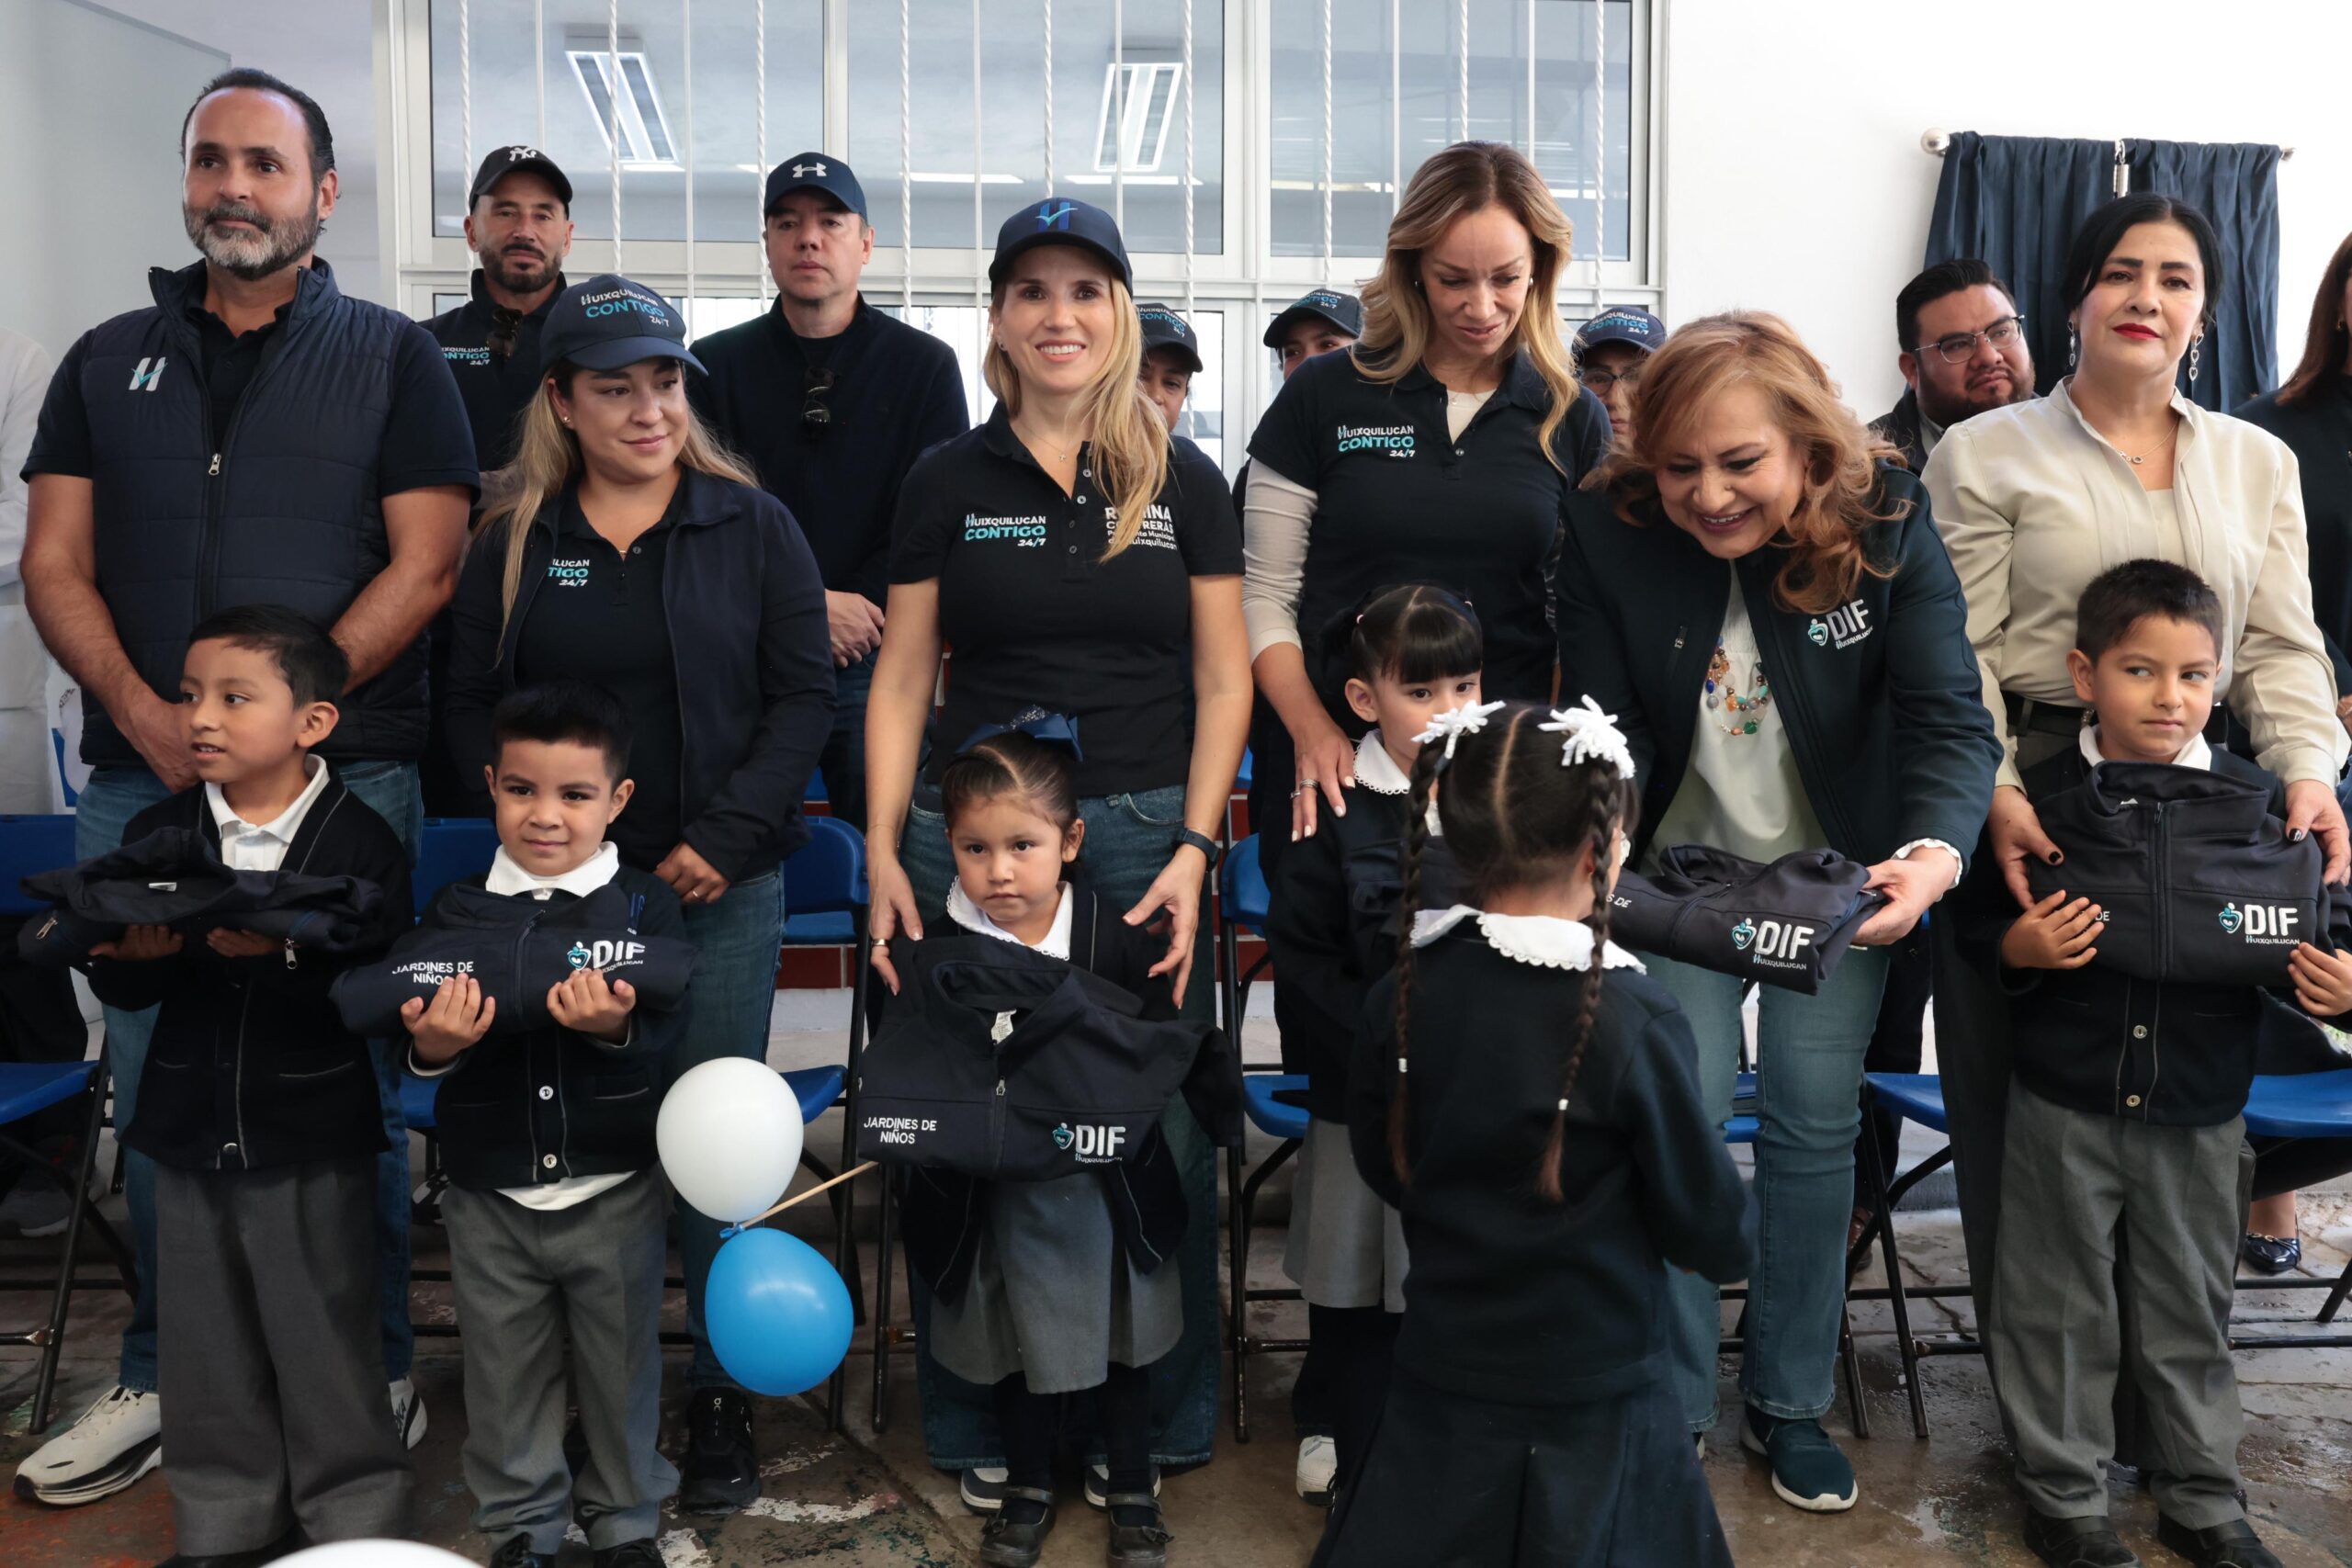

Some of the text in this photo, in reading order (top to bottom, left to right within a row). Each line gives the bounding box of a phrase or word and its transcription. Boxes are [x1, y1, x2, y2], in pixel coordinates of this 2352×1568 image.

[585, 299, 665, 318] CONTIGO
[649, 315, 670, 328] 24/7
[1587, 317, 1648, 333] CONTIGO
[1627, 326, 1650, 335] 24/7
[443, 352, 490, 360] NTIGO
[1337, 425, 1415, 440] HUIXQUILUCAN
[1338, 435, 1415, 452] CONTIGO
[1389, 448, 1416, 457] 24/7
[965, 513, 1046, 528] HUIXQUILUCAN
[1104, 504, 1172, 523] RINA
[964, 525, 1046, 541] CONTIGO
[1105, 520, 1174, 535] CRERAS
[1017, 536, 1046, 547] 24/7
[1131, 537, 1178, 551] uixquilucan
[547, 566, 589, 578] TIGO
[559, 578, 588, 587] 24/7
[1826, 599, 1869, 640] DIF
[1613, 897, 1633, 908] DE
[2245, 904, 2299, 936] DIF
[1754, 920, 1815, 960] DIF
[2245, 935, 2301, 945] HUIXQUILUCAN
[593, 940, 646, 969] DIF
[1753, 953, 1807, 970] HUIXQUILUCAN
[391, 961, 474, 975] JARDINES DE
[413, 971, 448, 986] NIÑO
[864, 1116, 937, 1132] JARDINES DE
[880, 1128, 916, 1145] NIÑOS
[1075, 1124, 1126, 1156] DIF
